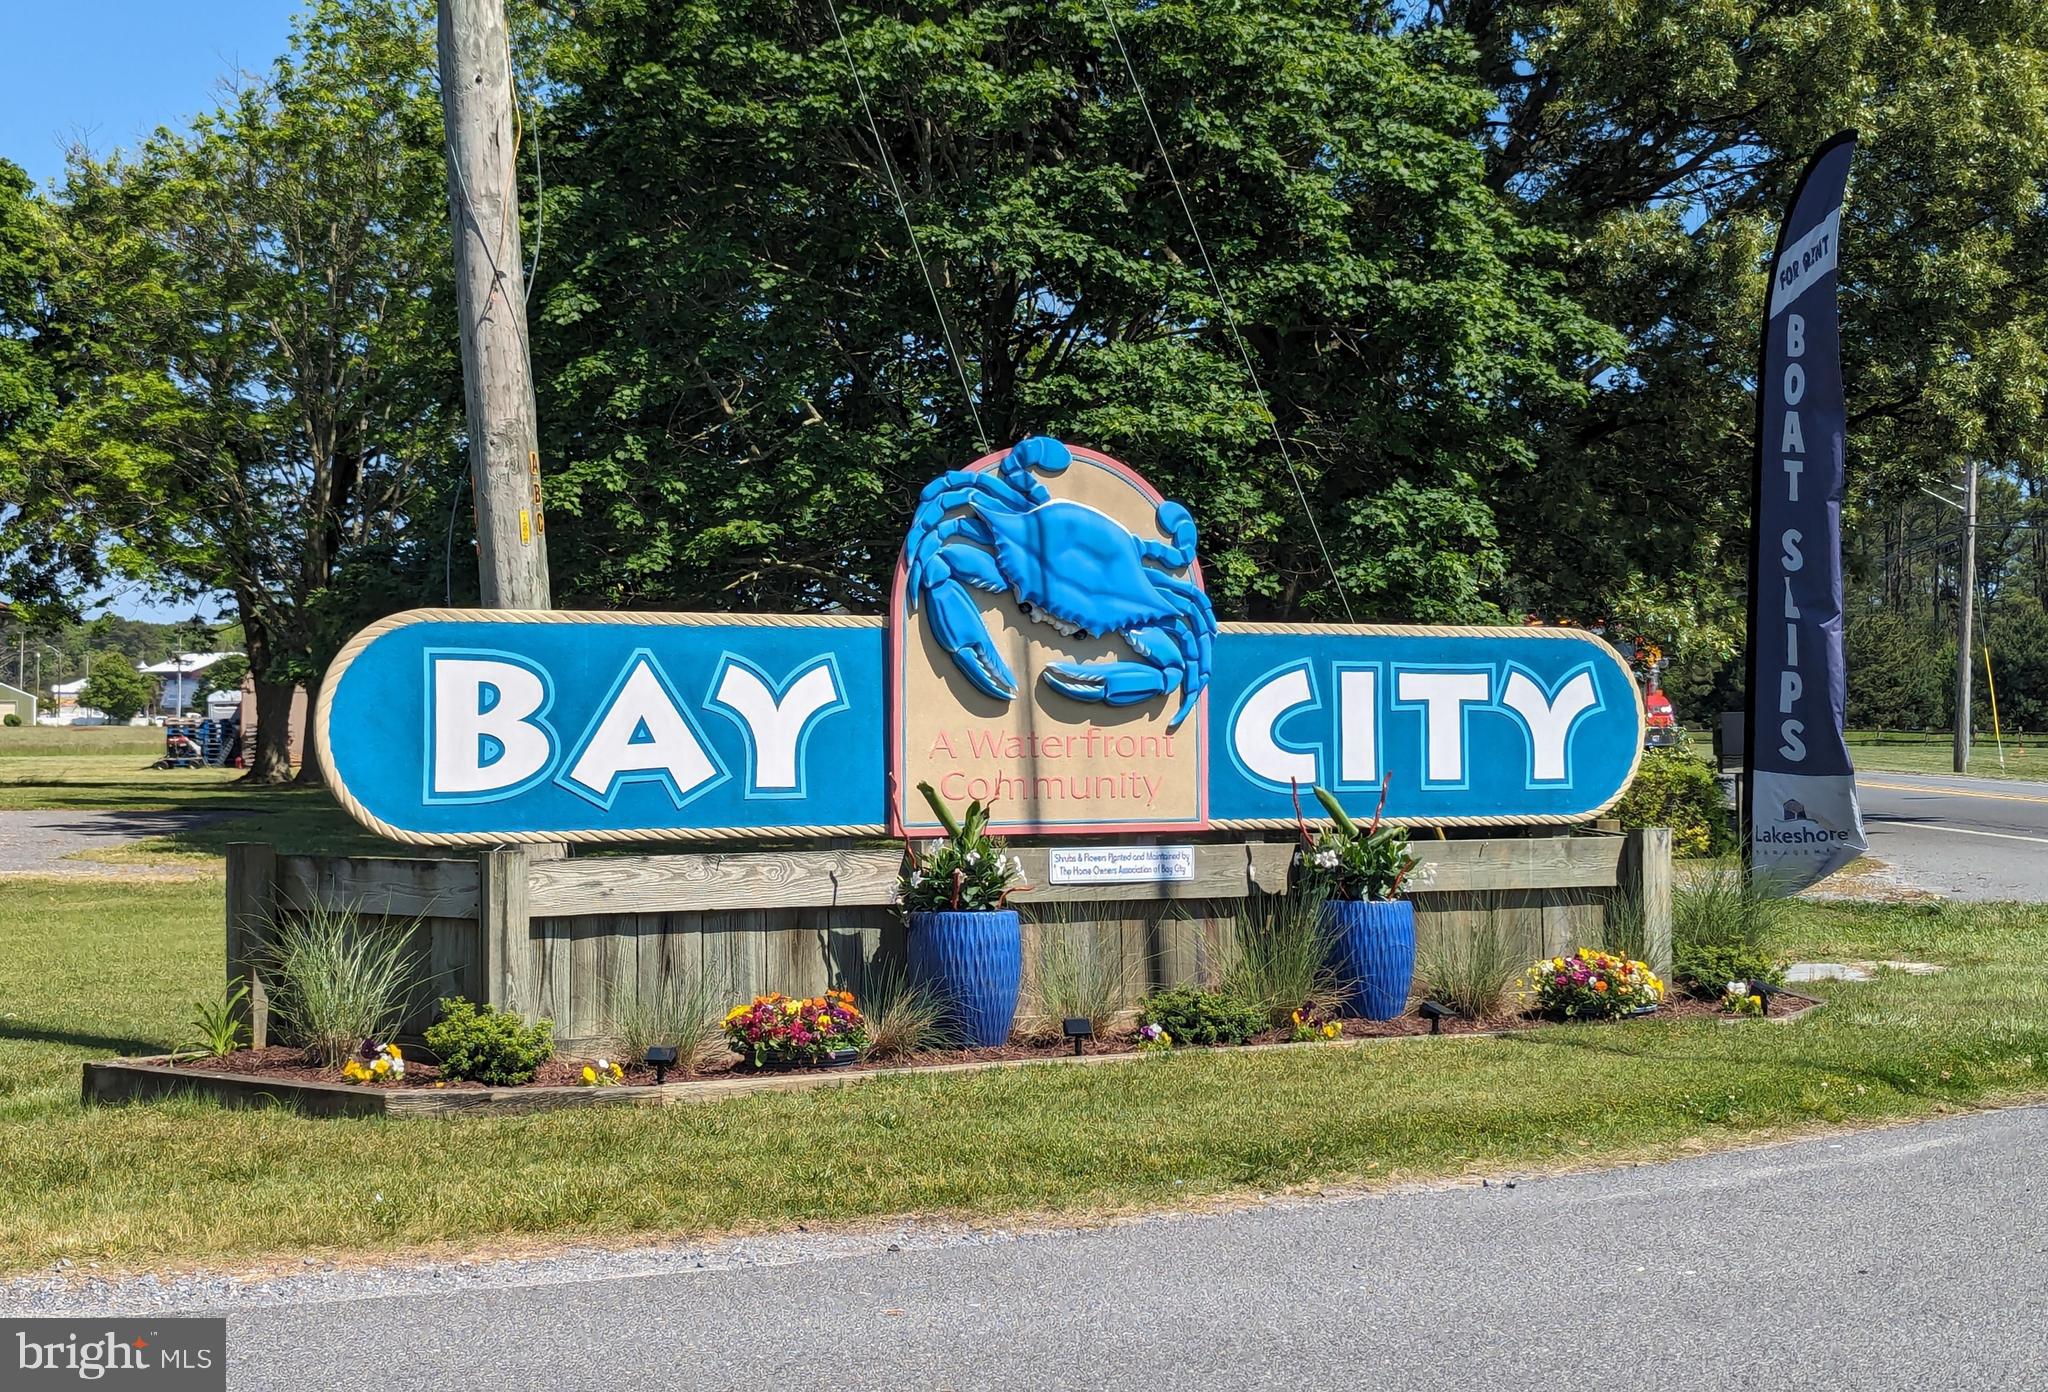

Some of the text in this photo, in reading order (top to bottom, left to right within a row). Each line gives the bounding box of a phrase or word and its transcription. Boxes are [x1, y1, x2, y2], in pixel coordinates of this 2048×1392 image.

[1780, 260, 1800, 290] FOR
[1778, 314, 1806, 762] BOAT SLIPS
[423, 647, 1606, 811] BAY CITY
[929, 727, 1176, 759] A Waterfront
[940, 769, 1162, 807] Community
[1755, 825, 1849, 844] Lakeshore
[1054, 851, 1190, 863] Shrubs & Flowers Planted and Maintained by
[1060, 864, 1187, 876] The Home Owners Association of Bay City
